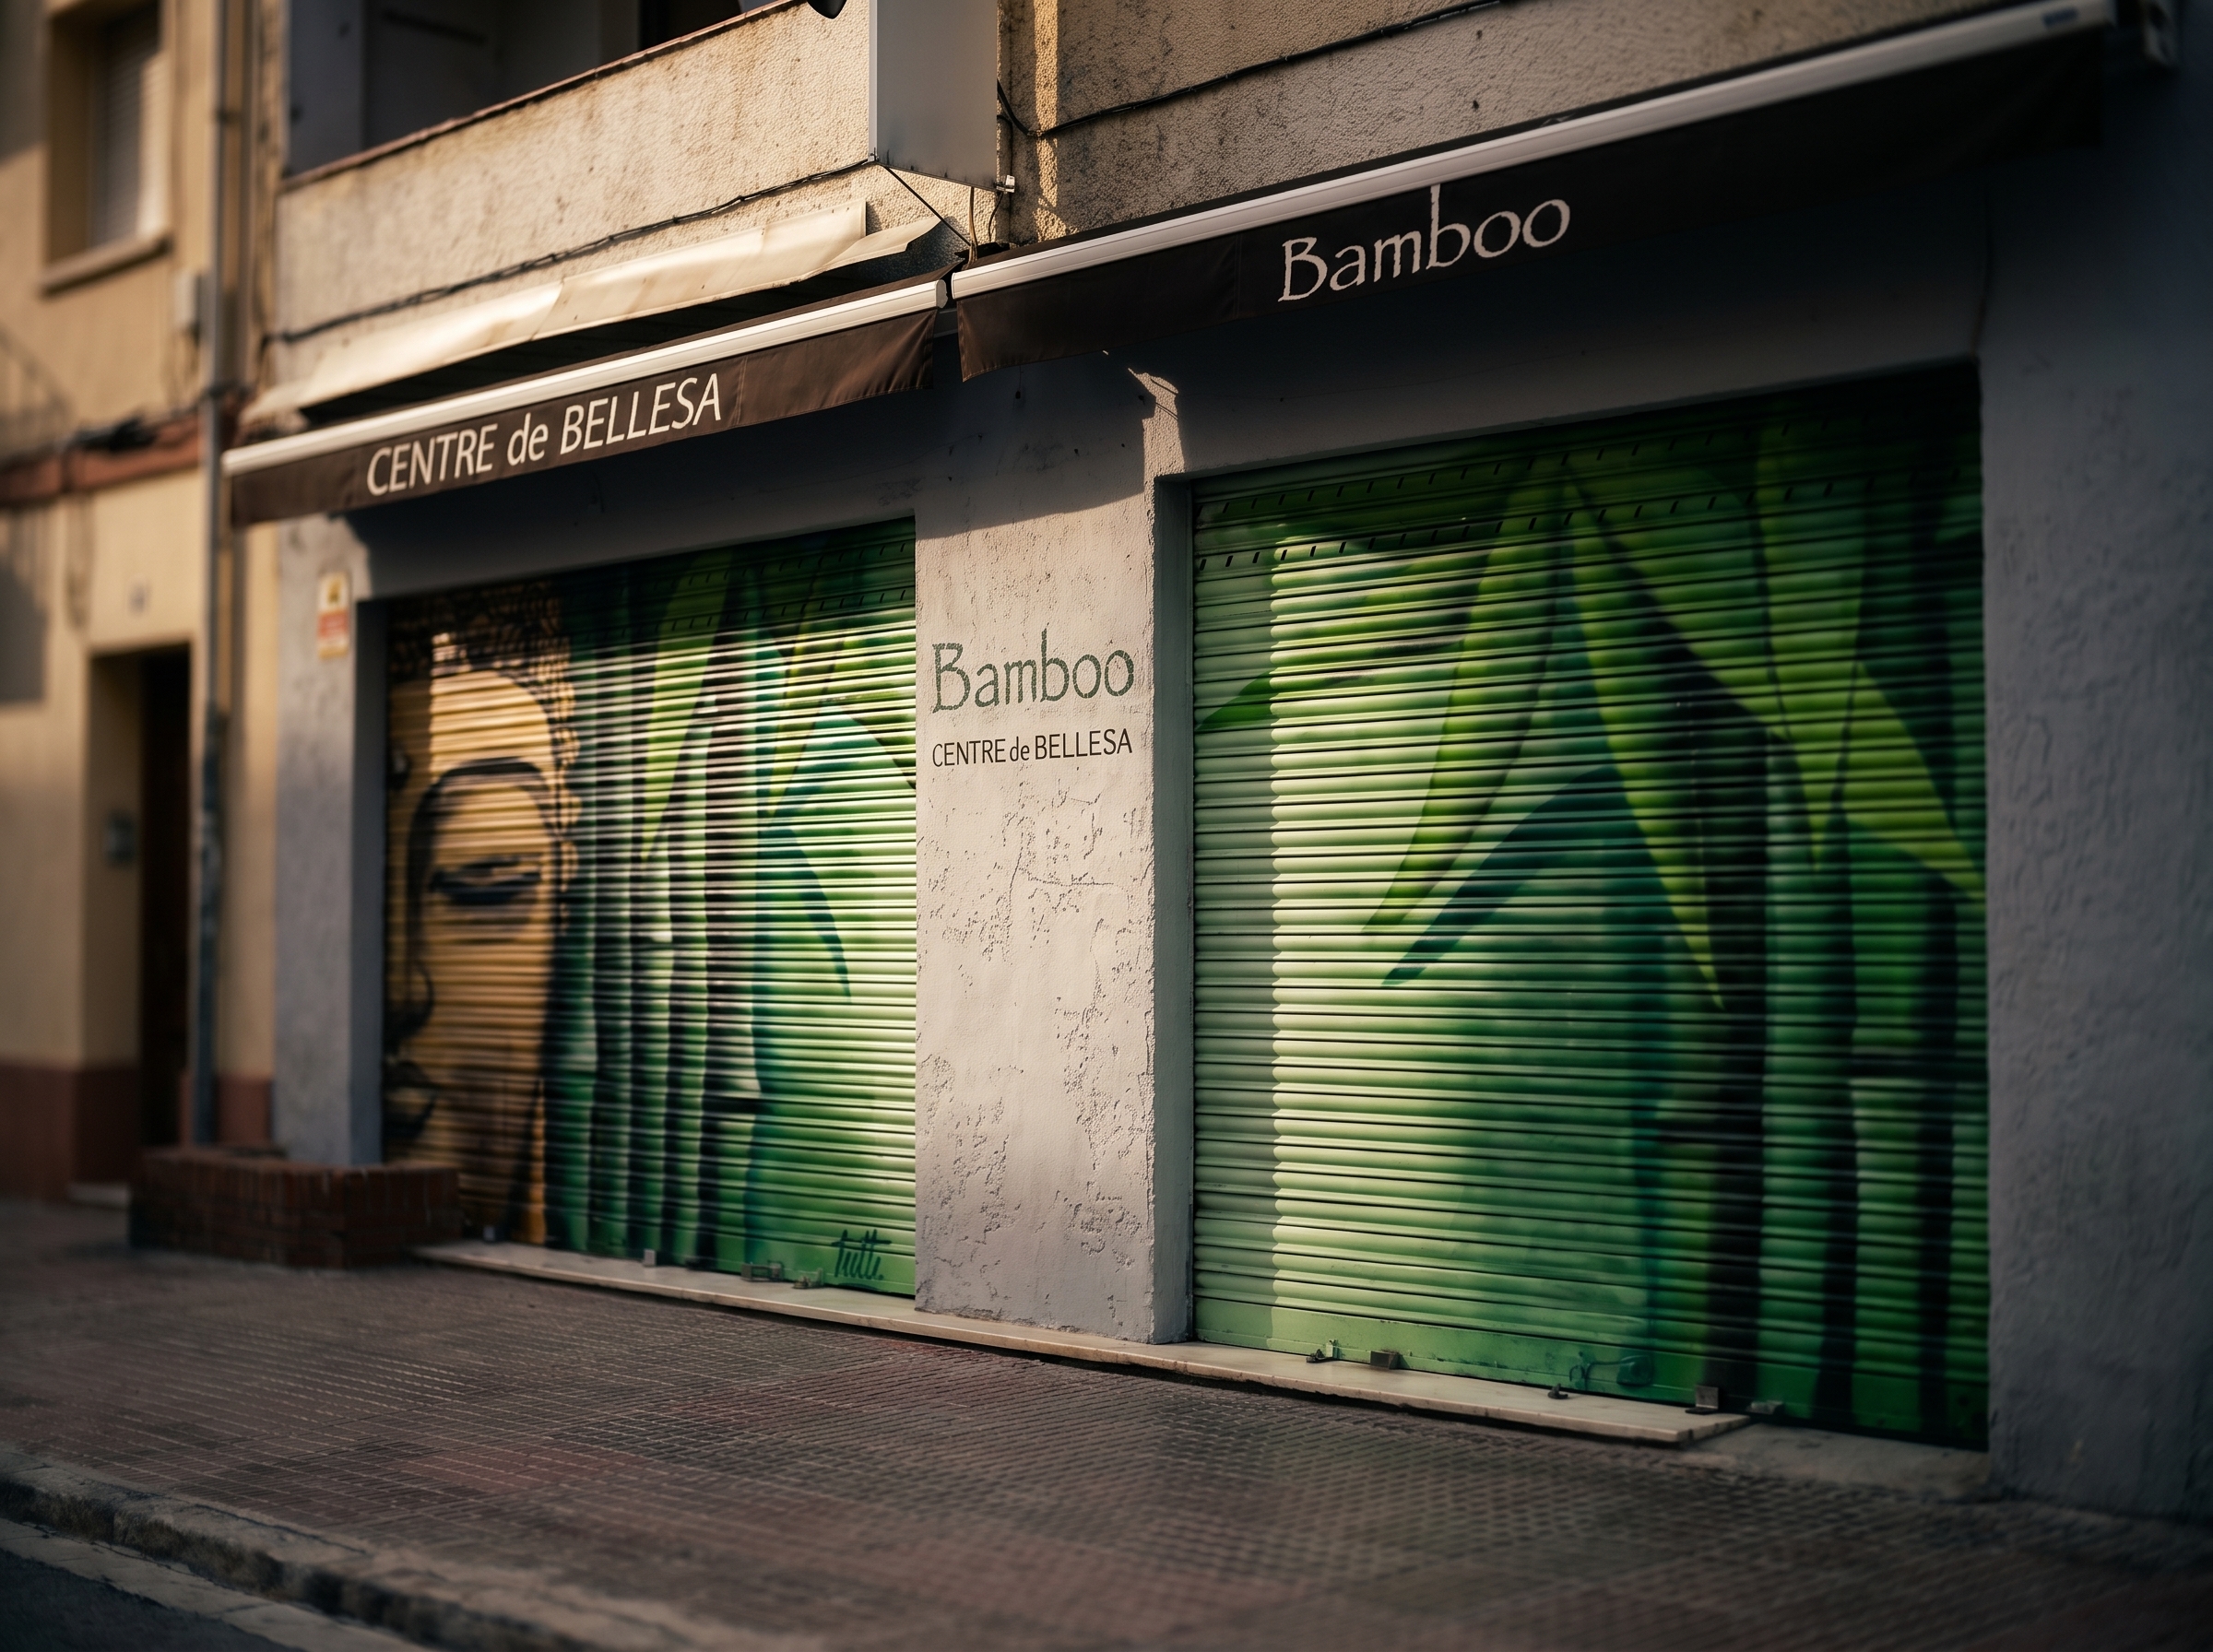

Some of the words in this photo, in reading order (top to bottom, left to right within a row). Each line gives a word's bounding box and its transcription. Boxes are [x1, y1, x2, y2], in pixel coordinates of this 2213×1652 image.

[1278, 183, 1570, 302] Bamboo
[367, 423, 498, 496] CENTRE
[506, 412, 549, 466] de
[560, 372, 722, 454] BELLESA
[932, 628, 1134, 714] Bamboo
[932, 738, 1006, 767] CENTRE
[1010, 736, 1030, 761] de
[1035, 727, 1133, 760] BELLESA
